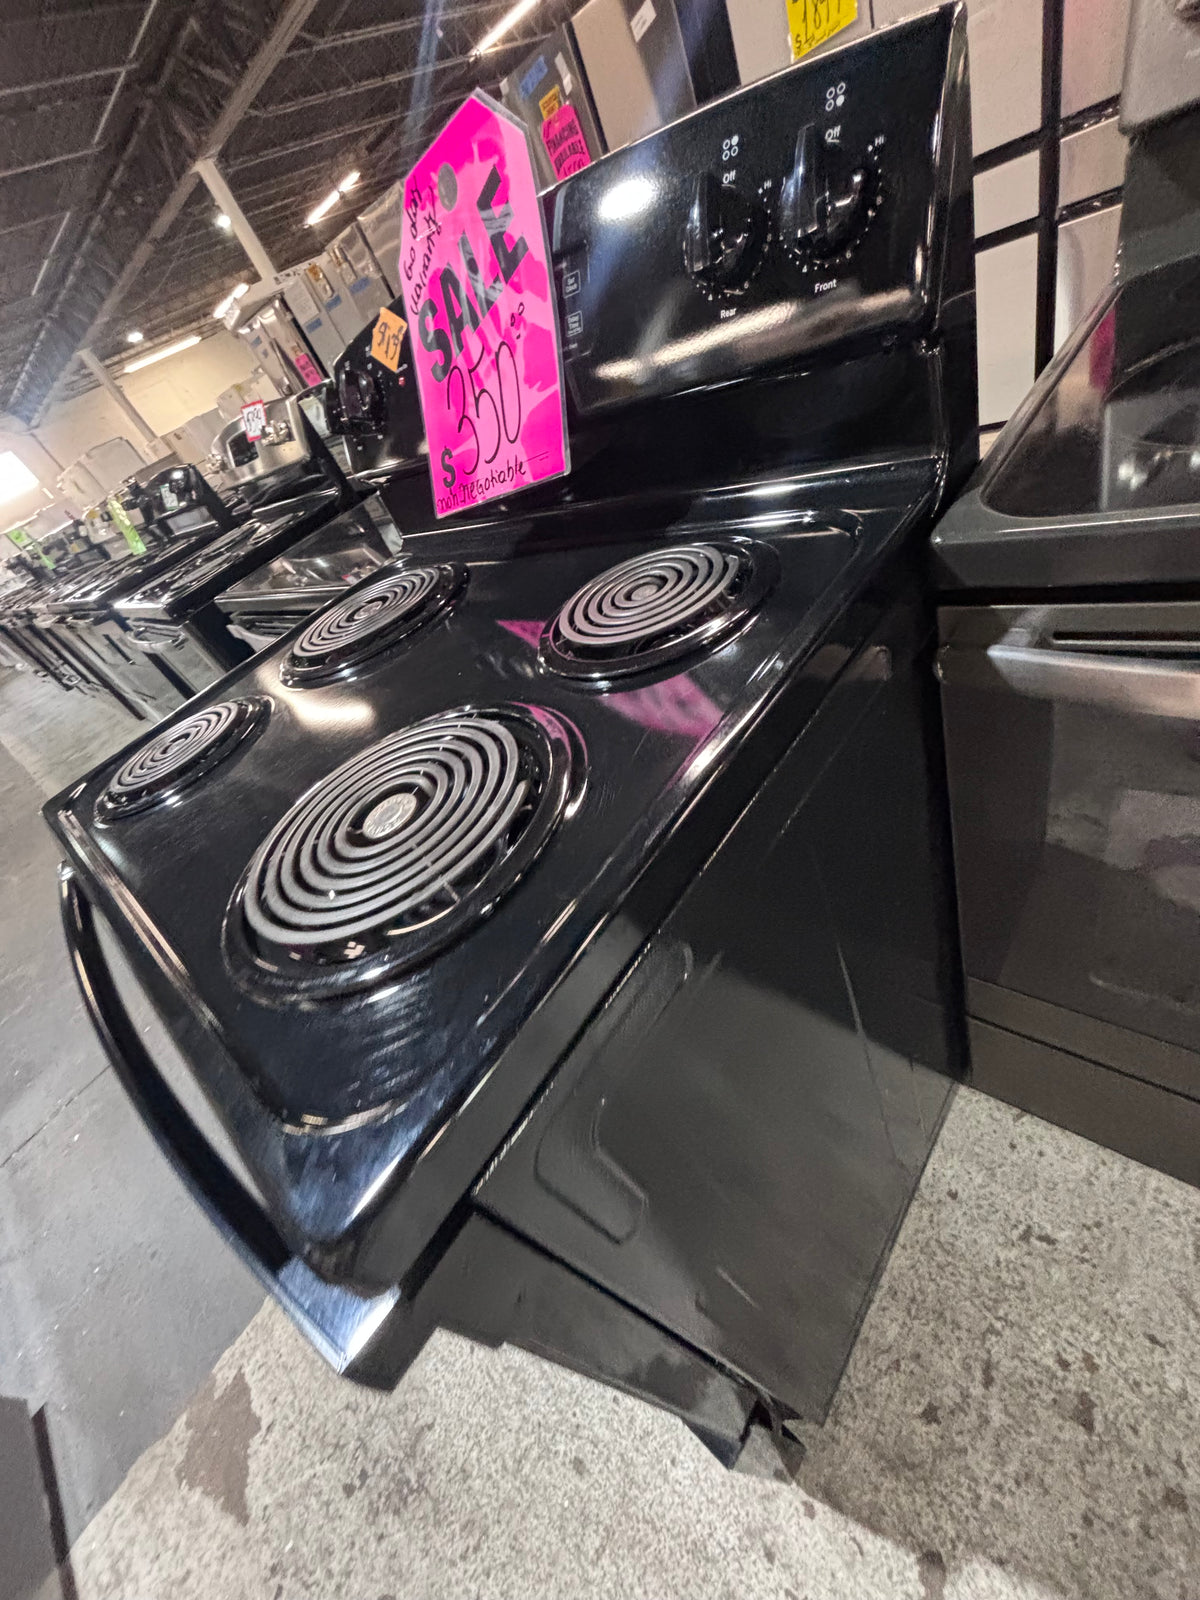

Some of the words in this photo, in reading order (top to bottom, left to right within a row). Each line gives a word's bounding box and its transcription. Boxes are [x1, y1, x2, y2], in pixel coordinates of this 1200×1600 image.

[825, 125, 841, 140] Off
[874, 135, 885, 146] Hi
[722, 170, 736, 184] Off
[406, 176, 423, 239] day
[404, 247, 416, 281] 60
[418, 164, 529, 383] SALE
[814, 278, 837, 293] Front
[720, 306, 737, 319] Rear
